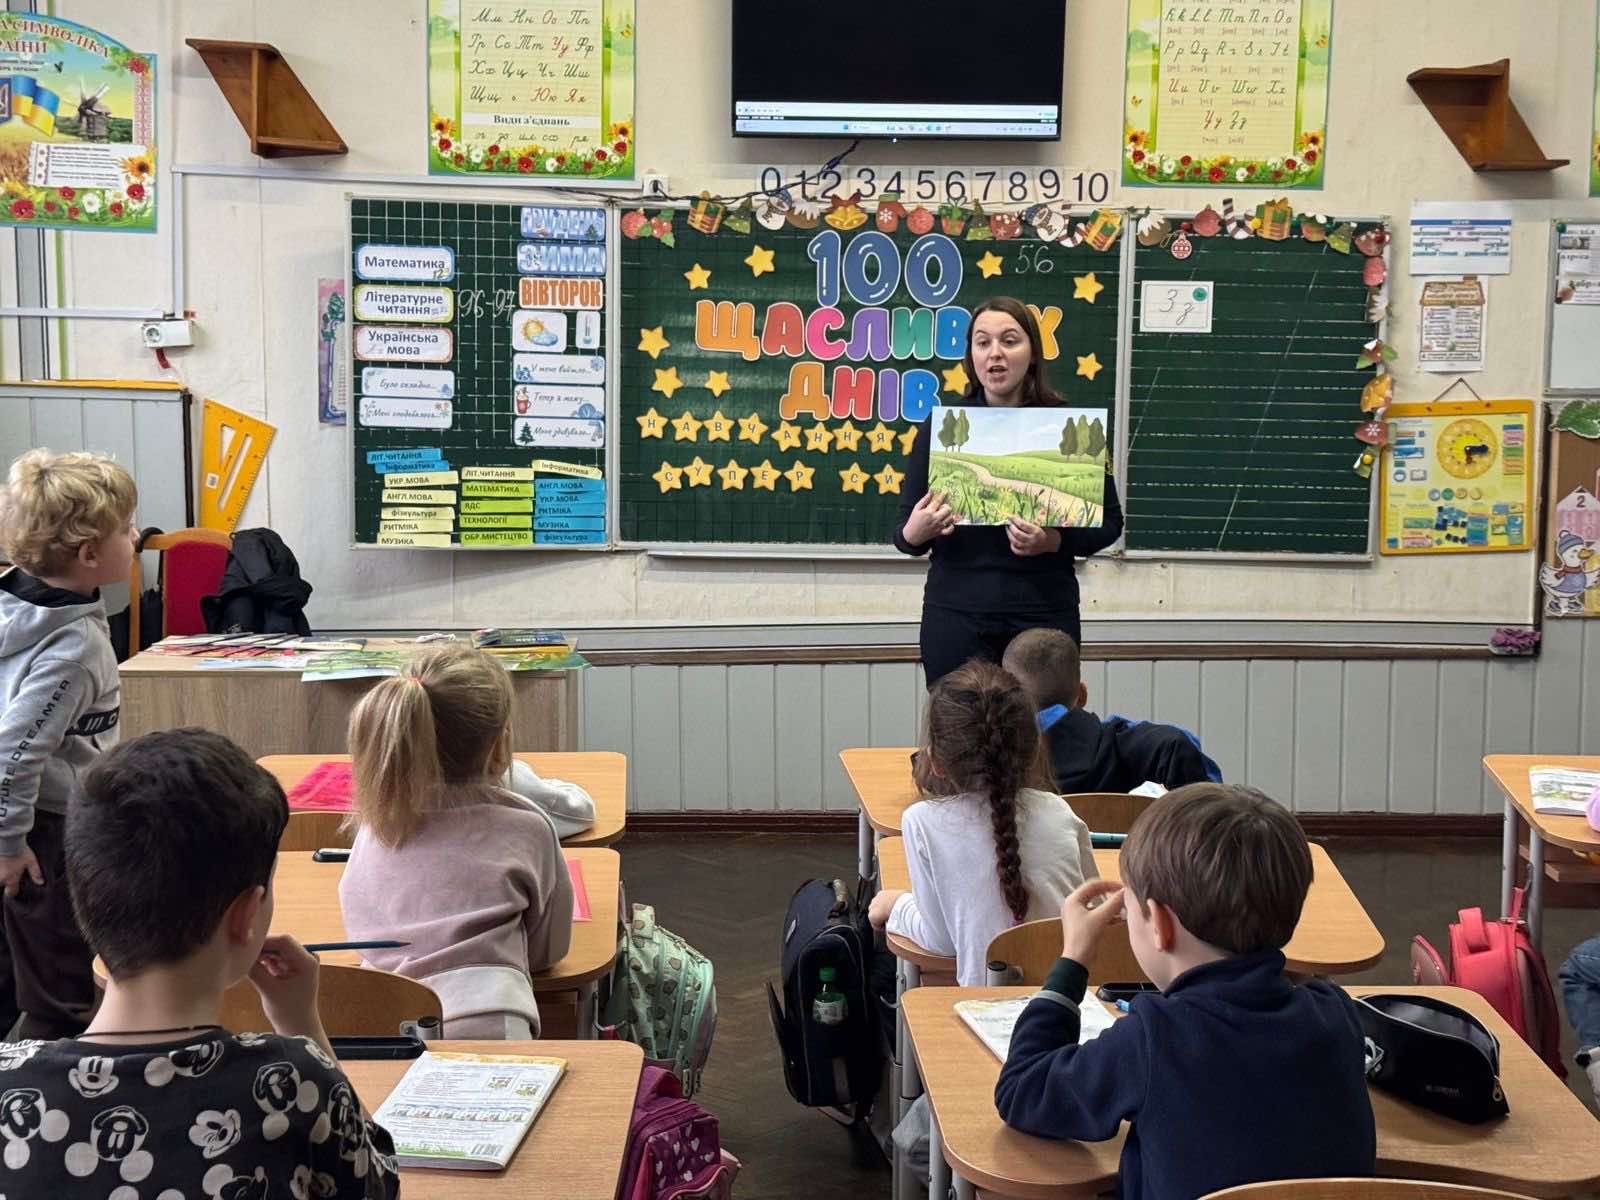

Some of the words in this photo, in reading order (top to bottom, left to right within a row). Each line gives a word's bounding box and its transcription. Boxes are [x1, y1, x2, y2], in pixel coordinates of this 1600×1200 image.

[761, 167, 781, 196] 0
[821, 170, 841, 199] 2
[857, 168, 876, 198] 3
[883, 171, 905, 200] 4
[917, 170, 936, 199] 5
[945, 171, 966, 200] 6
[975, 172, 996, 200] 7
[1009, 171, 1027, 200] 8
[1039, 169, 1060, 198] 9
[1073, 172, 1108, 201] 10
[365, 256, 445, 269] Математика
[1015, 244, 1054, 274] 56
[808, 230, 963, 307] 100
[365, 291, 443, 305] Літературне
[521, 279, 601, 306] ВІВТОРОК
[378, 307, 430, 315] читання
[695, 300, 1064, 361] ЩАСЛИВХ
[368, 331, 438, 344] Українська
[387, 347, 420, 355] мова
[779, 361, 942, 422] ДНІВ
[464, 470, 516, 478] ЛІТ.ЧИТАННЯ
[466, 485, 520, 493] МАТЕМАТИКА
[1576, 495, 1586, 508] 2
[463, 516, 508, 524] ТЕХНОЛОГІЇ
[383, 523, 419, 531] РИТМІКА
[12, 679, 71, 762] DREAMER
